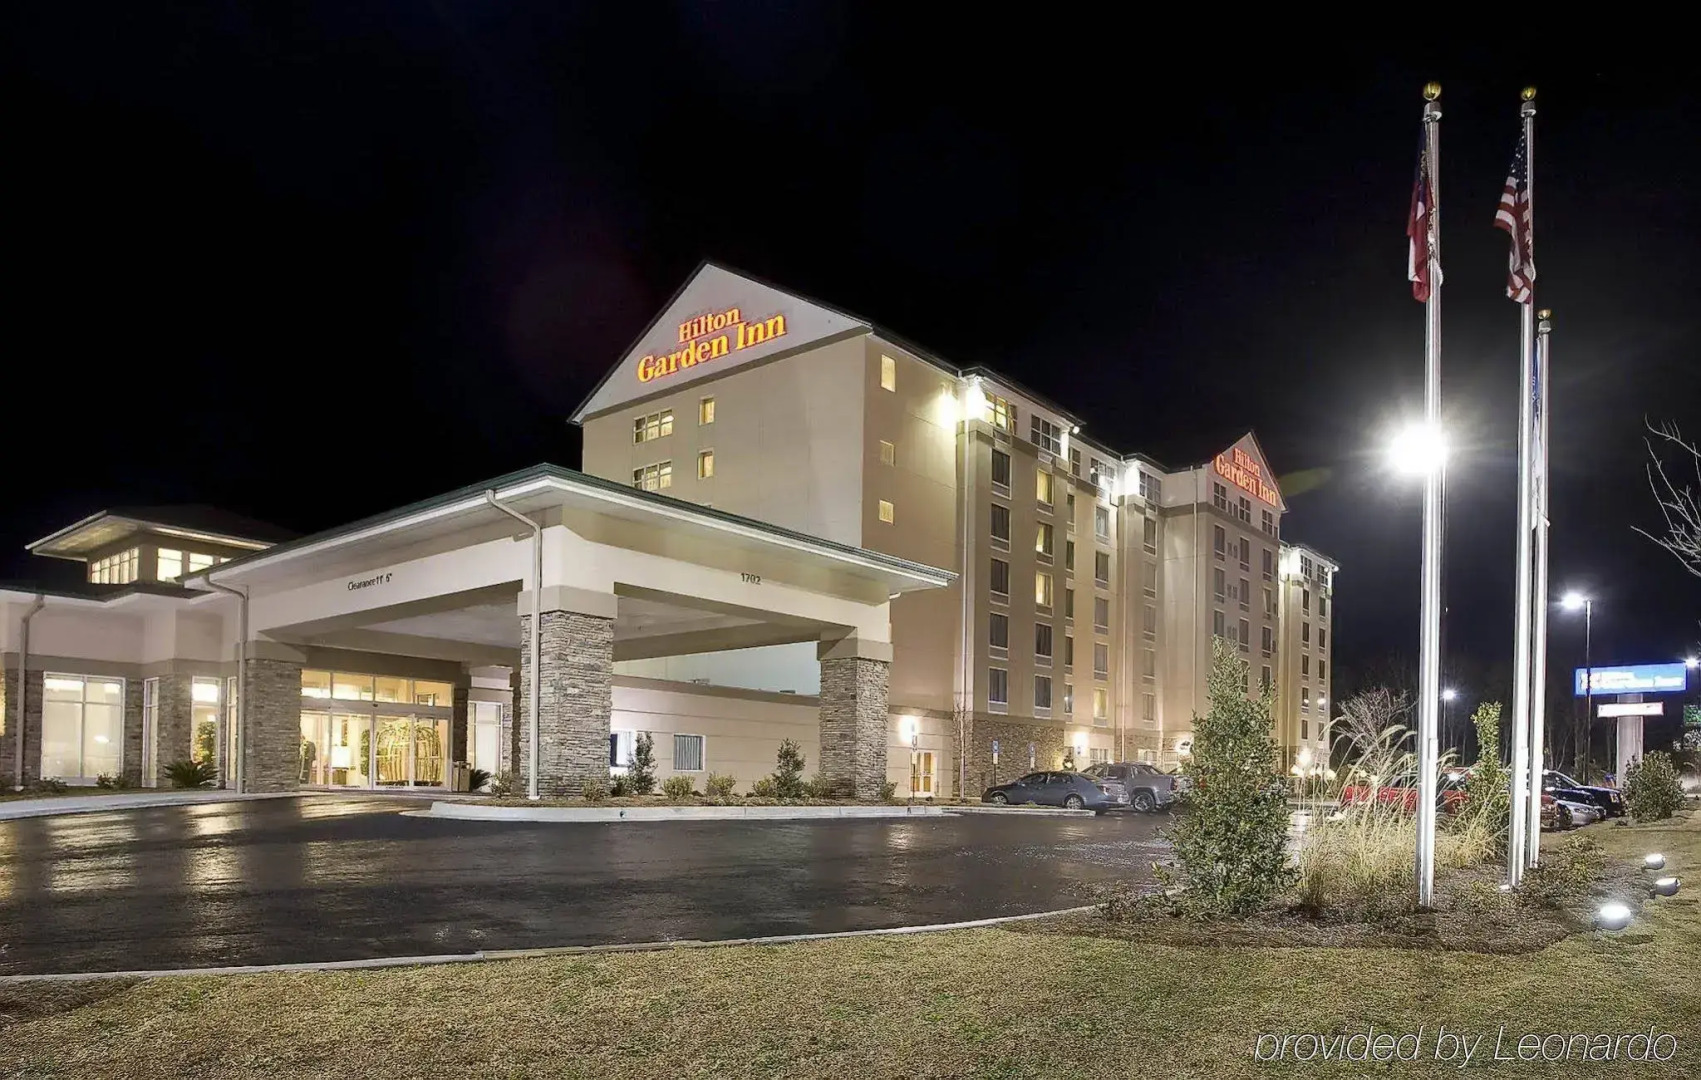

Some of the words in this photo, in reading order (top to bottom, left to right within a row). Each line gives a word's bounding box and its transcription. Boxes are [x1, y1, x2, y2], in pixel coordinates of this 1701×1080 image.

[678, 307, 741, 343] Hilton
[637, 334, 729, 383] Garden
[736, 313, 787, 350] Inn
[1215, 453, 1257, 495] Garden
[1258, 478, 1277, 507] Inn
[1233, 448, 1261, 476] Hilton
[741, 573, 761, 585] 1702
